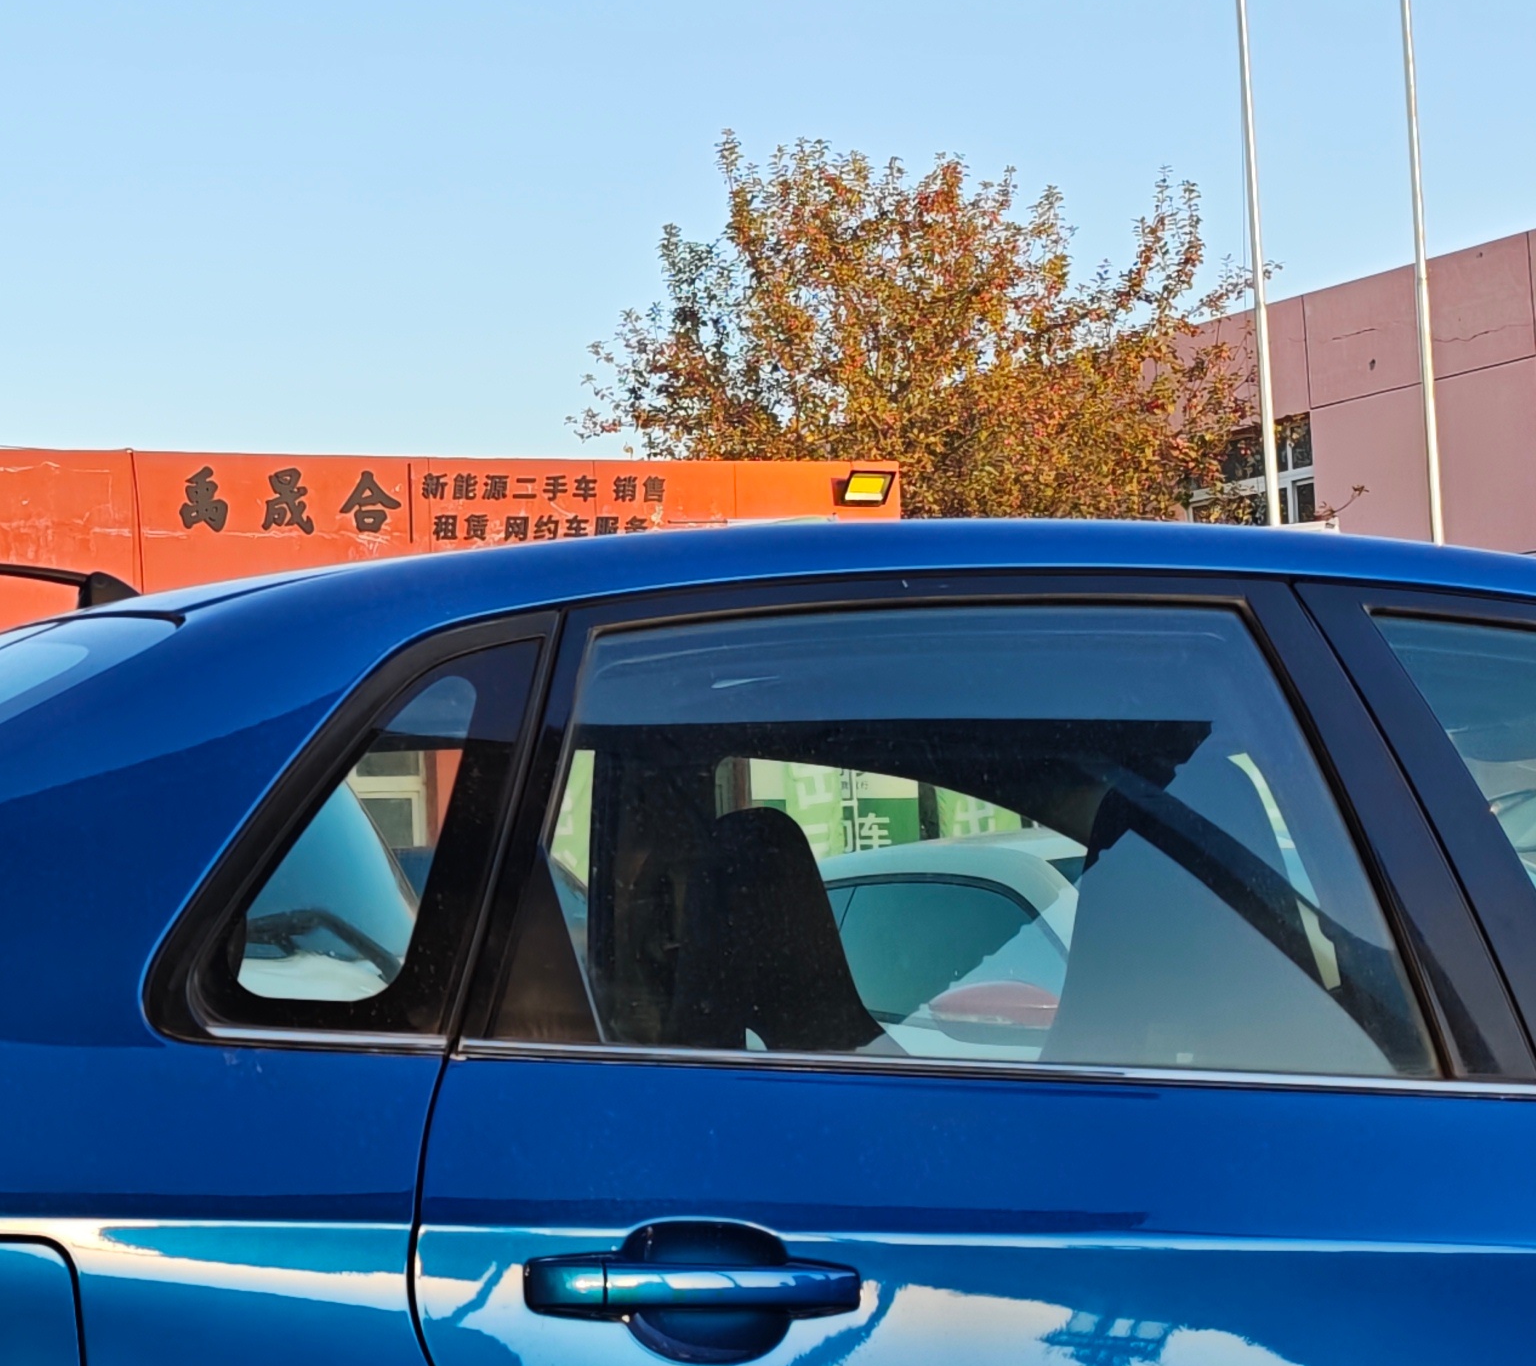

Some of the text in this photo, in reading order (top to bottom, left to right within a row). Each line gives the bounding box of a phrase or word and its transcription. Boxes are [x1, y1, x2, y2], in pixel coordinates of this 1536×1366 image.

[421, 473, 666, 503] 新能源二手车 销售
[432, 514, 489, 540] 租赁
